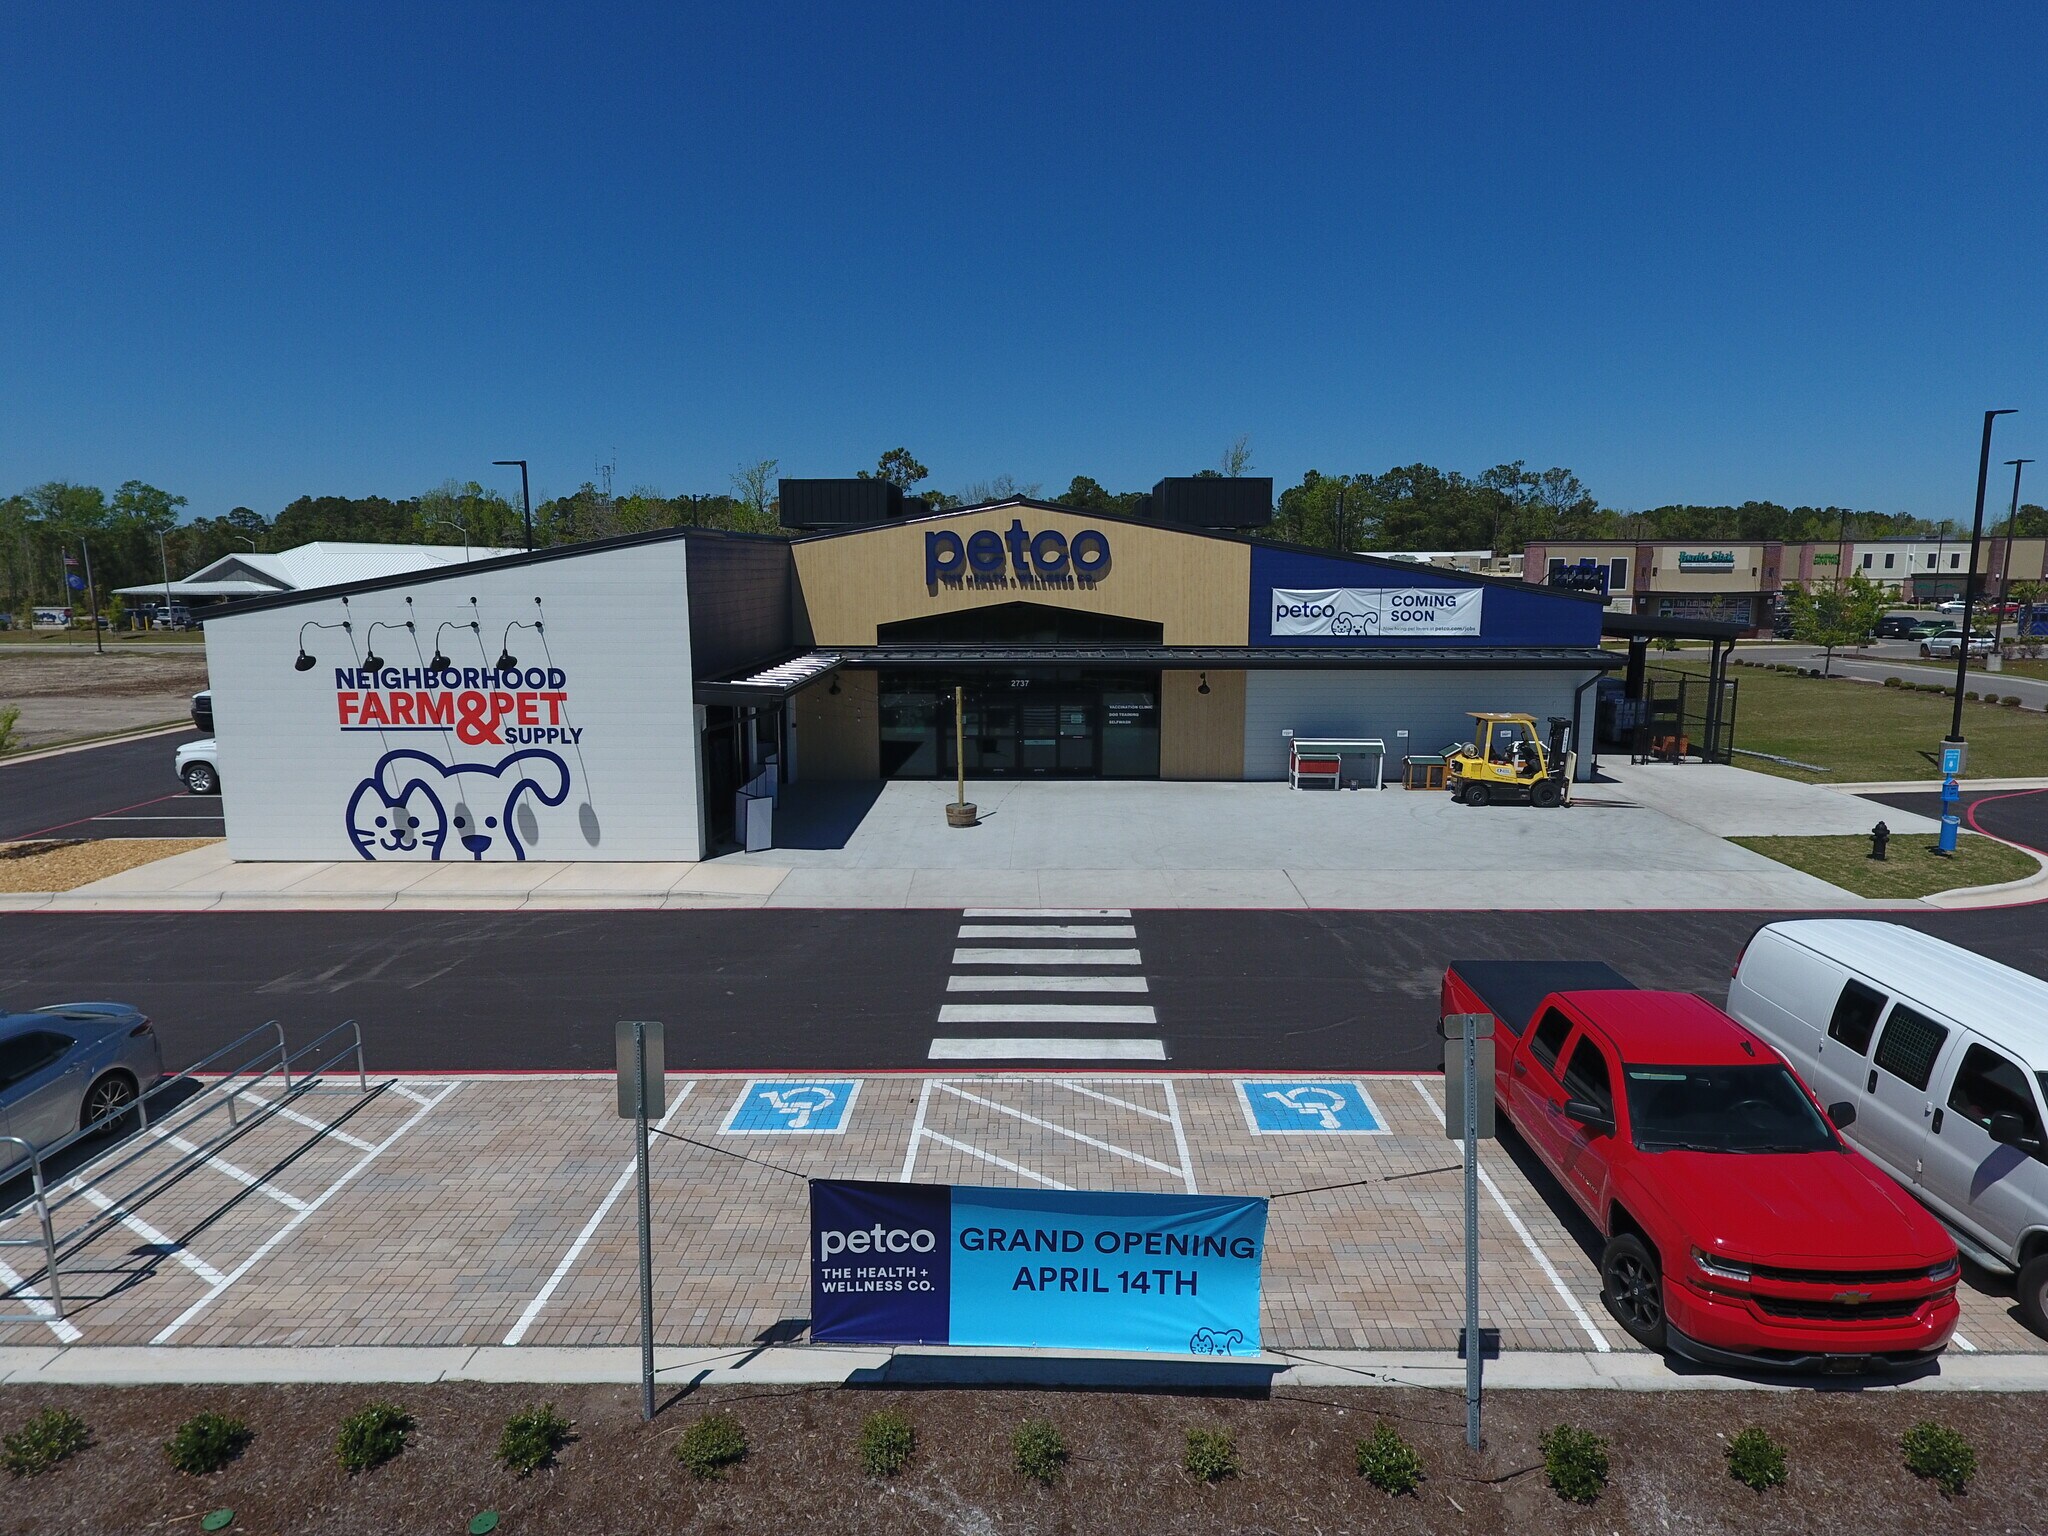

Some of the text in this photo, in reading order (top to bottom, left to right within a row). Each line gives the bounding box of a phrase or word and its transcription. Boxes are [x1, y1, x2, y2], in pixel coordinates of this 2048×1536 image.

[925, 520, 1109, 585] petco
[1391, 595, 1457, 608] COMING
[1276, 602, 1335, 622] petco
[1391, 610, 1435, 622] SOON
[334, 667, 566, 690] NEIGHBORHOOD
[504, 727, 583, 744] SUPPLY
[821, 1223, 936, 1262] petco
[959, 1227, 1255, 1260] GRAND OPENING
[822, 1267, 853, 1279] THE
[857, 1266, 916, 1278] HEALTH
[1012, 1266, 1198, 1296] APRIL 14TH
[822, 1280, 935, 1293] WELLNESS CO.
